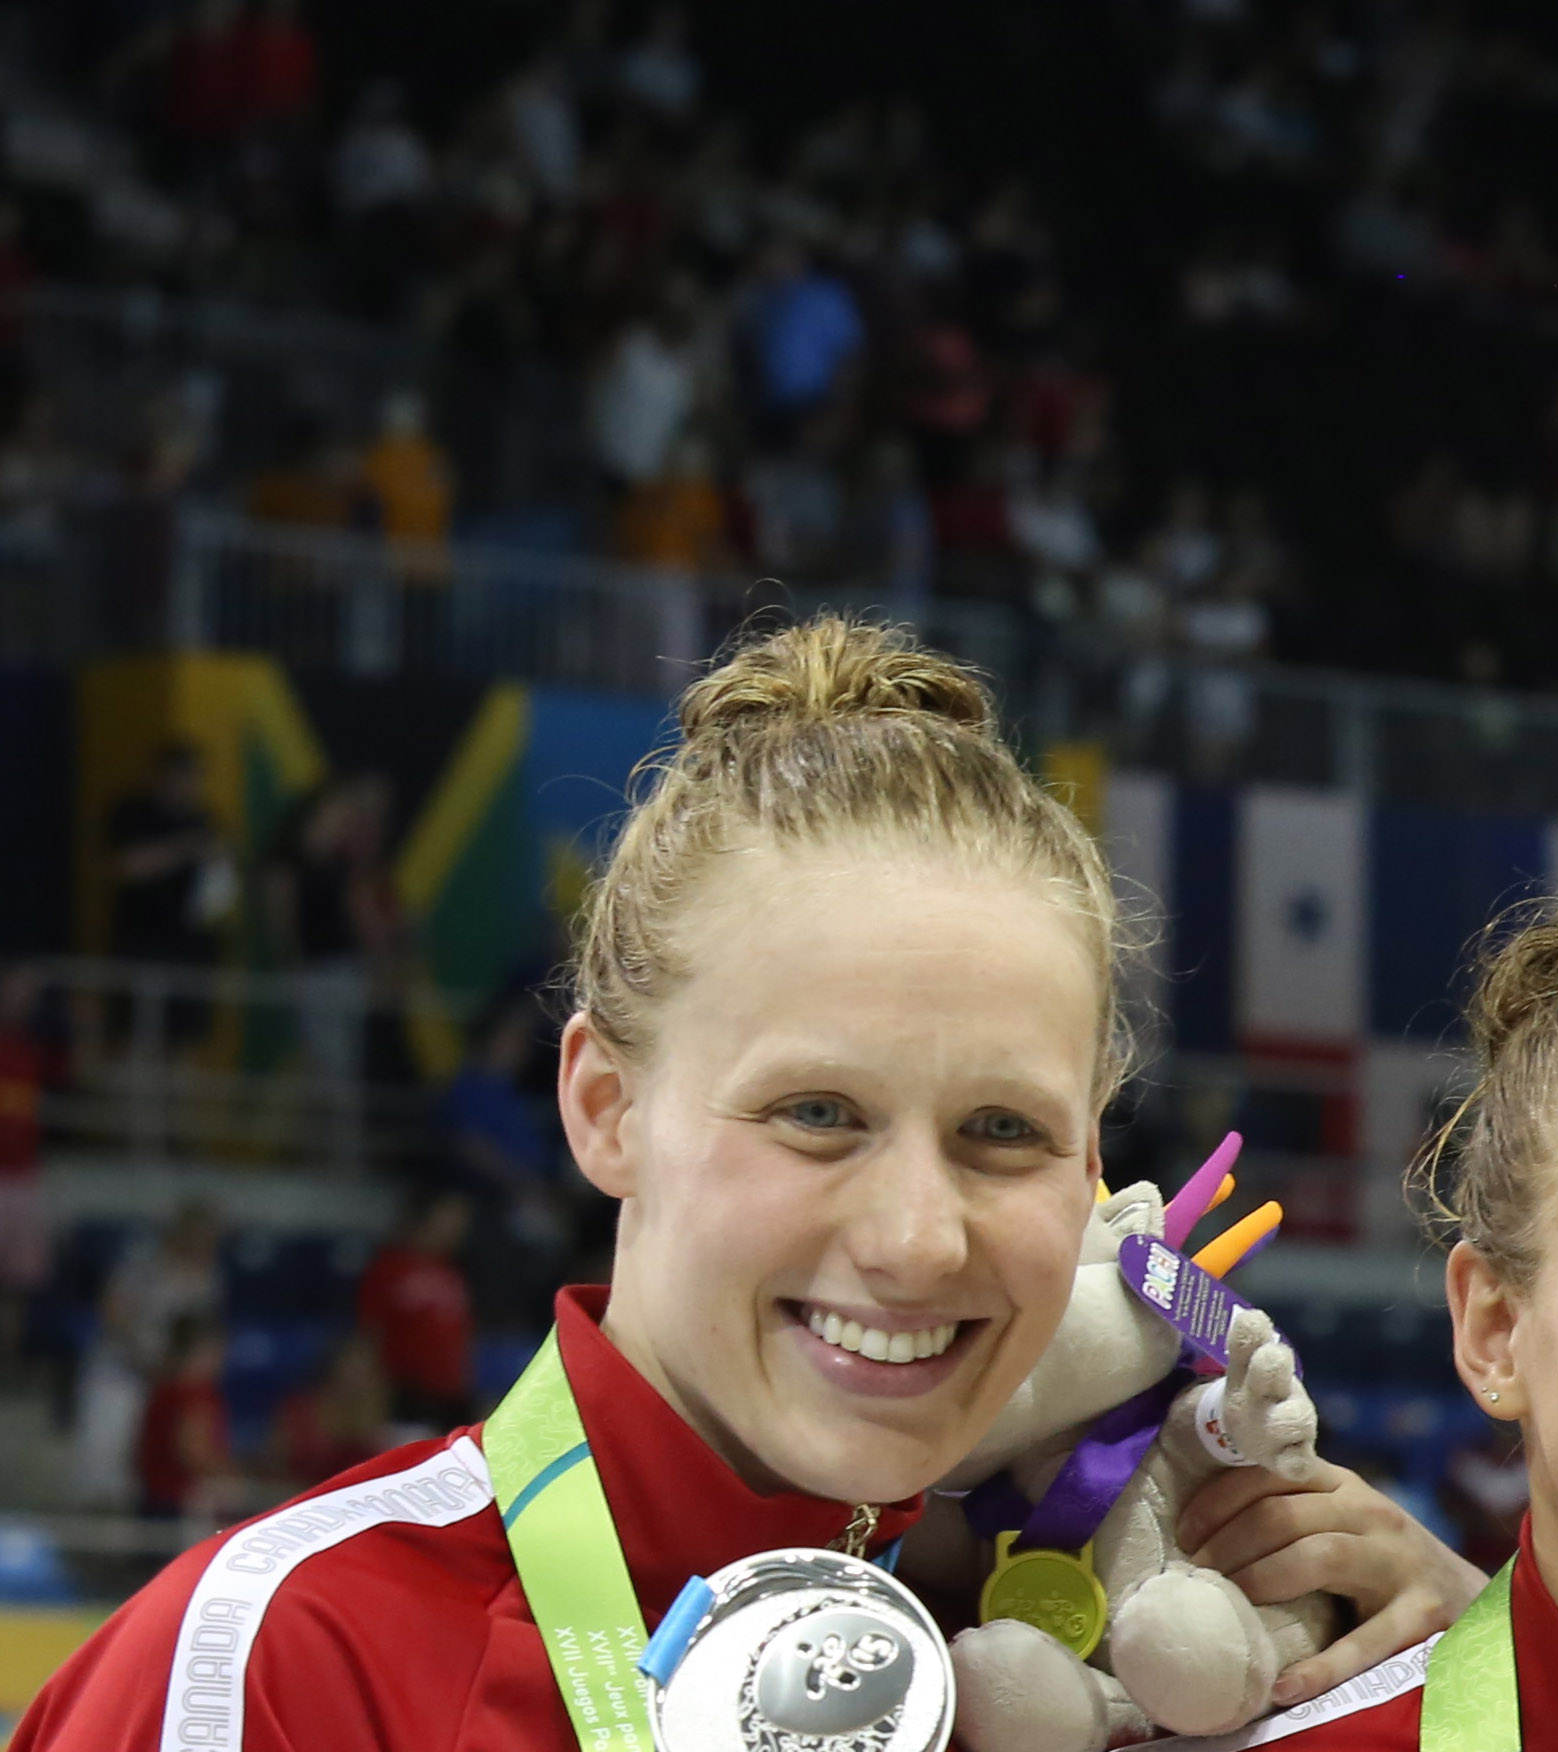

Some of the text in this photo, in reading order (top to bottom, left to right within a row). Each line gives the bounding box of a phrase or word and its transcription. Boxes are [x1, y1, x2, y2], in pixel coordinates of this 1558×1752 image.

[554, 1625, 583, 1662] XVII
[567, 1666, 601, 1726] Juegos
[604, 1681, 629, 1719] Jeux
